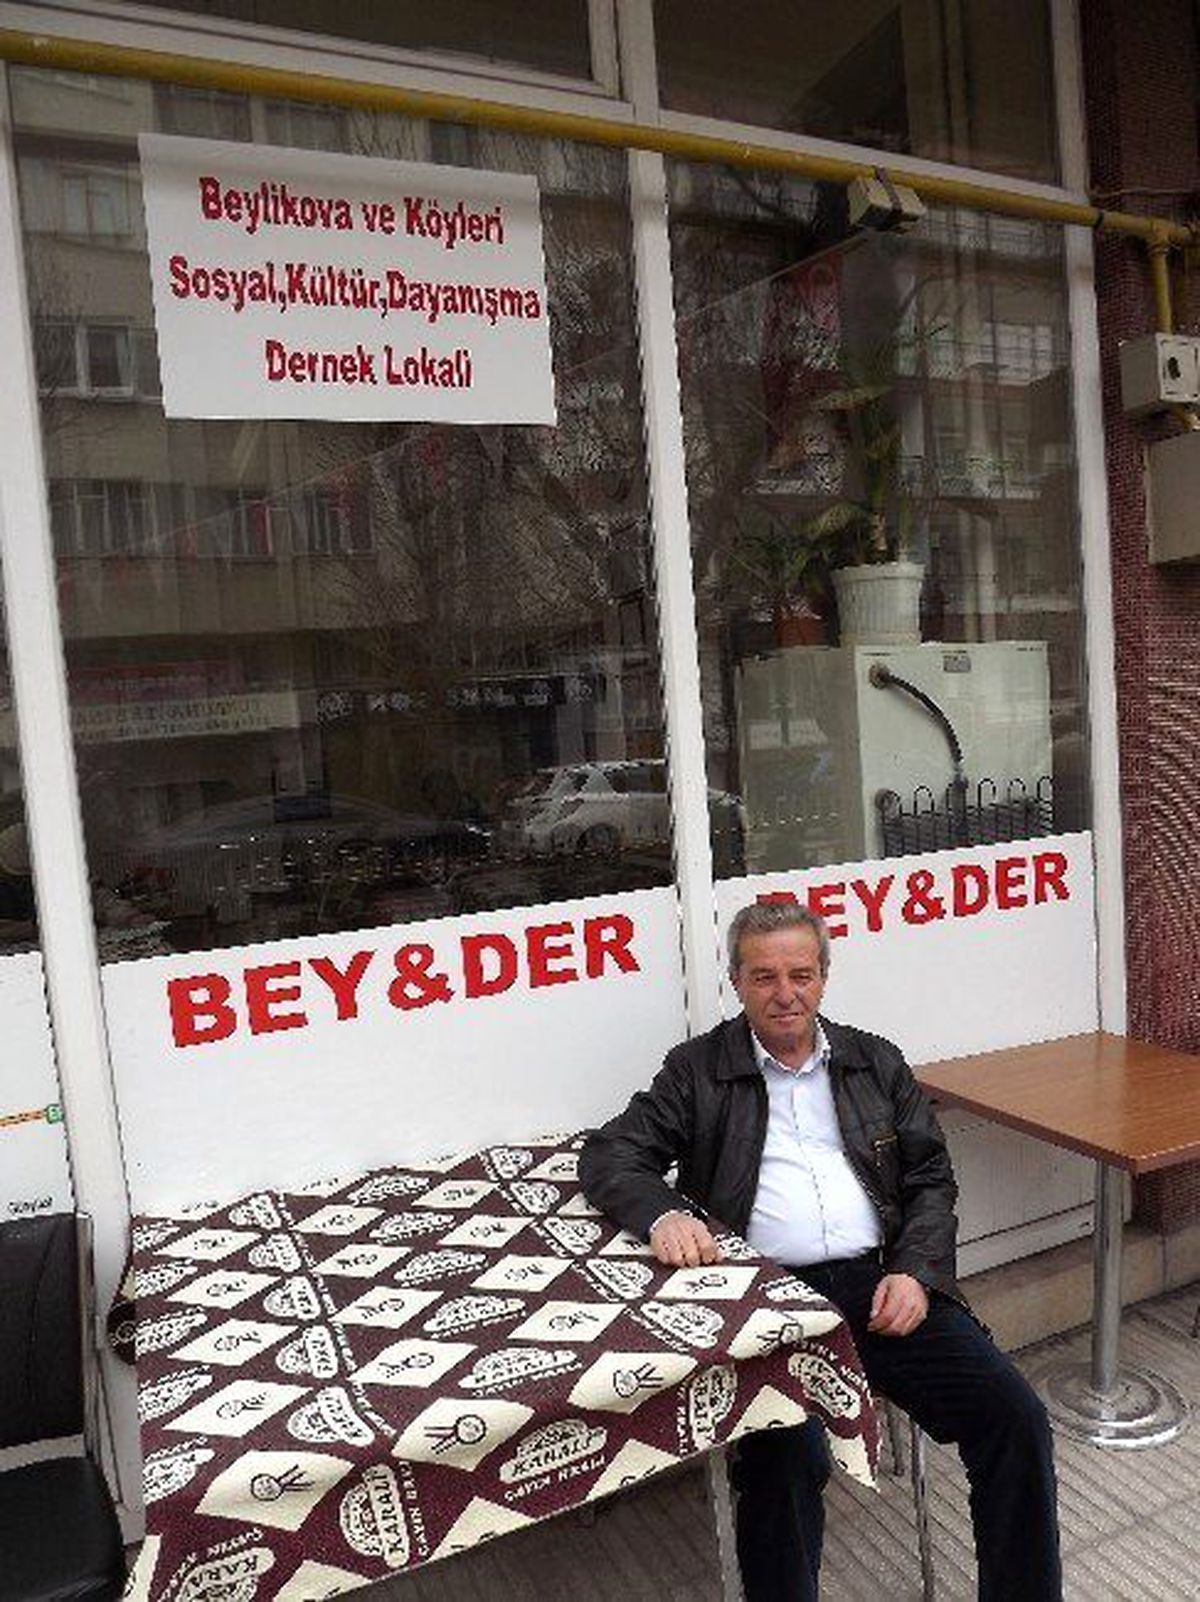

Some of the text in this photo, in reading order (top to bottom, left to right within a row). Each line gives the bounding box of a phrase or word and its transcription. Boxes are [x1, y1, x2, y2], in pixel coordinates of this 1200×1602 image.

[200, 177, 504, 250] Beylikova ve Köyleri
[265, 340, 473, 388] Dernek Lokali
[756, 851, 1070, 939] EY&DER
[167, 914, 639, 1049] BEY&DER
